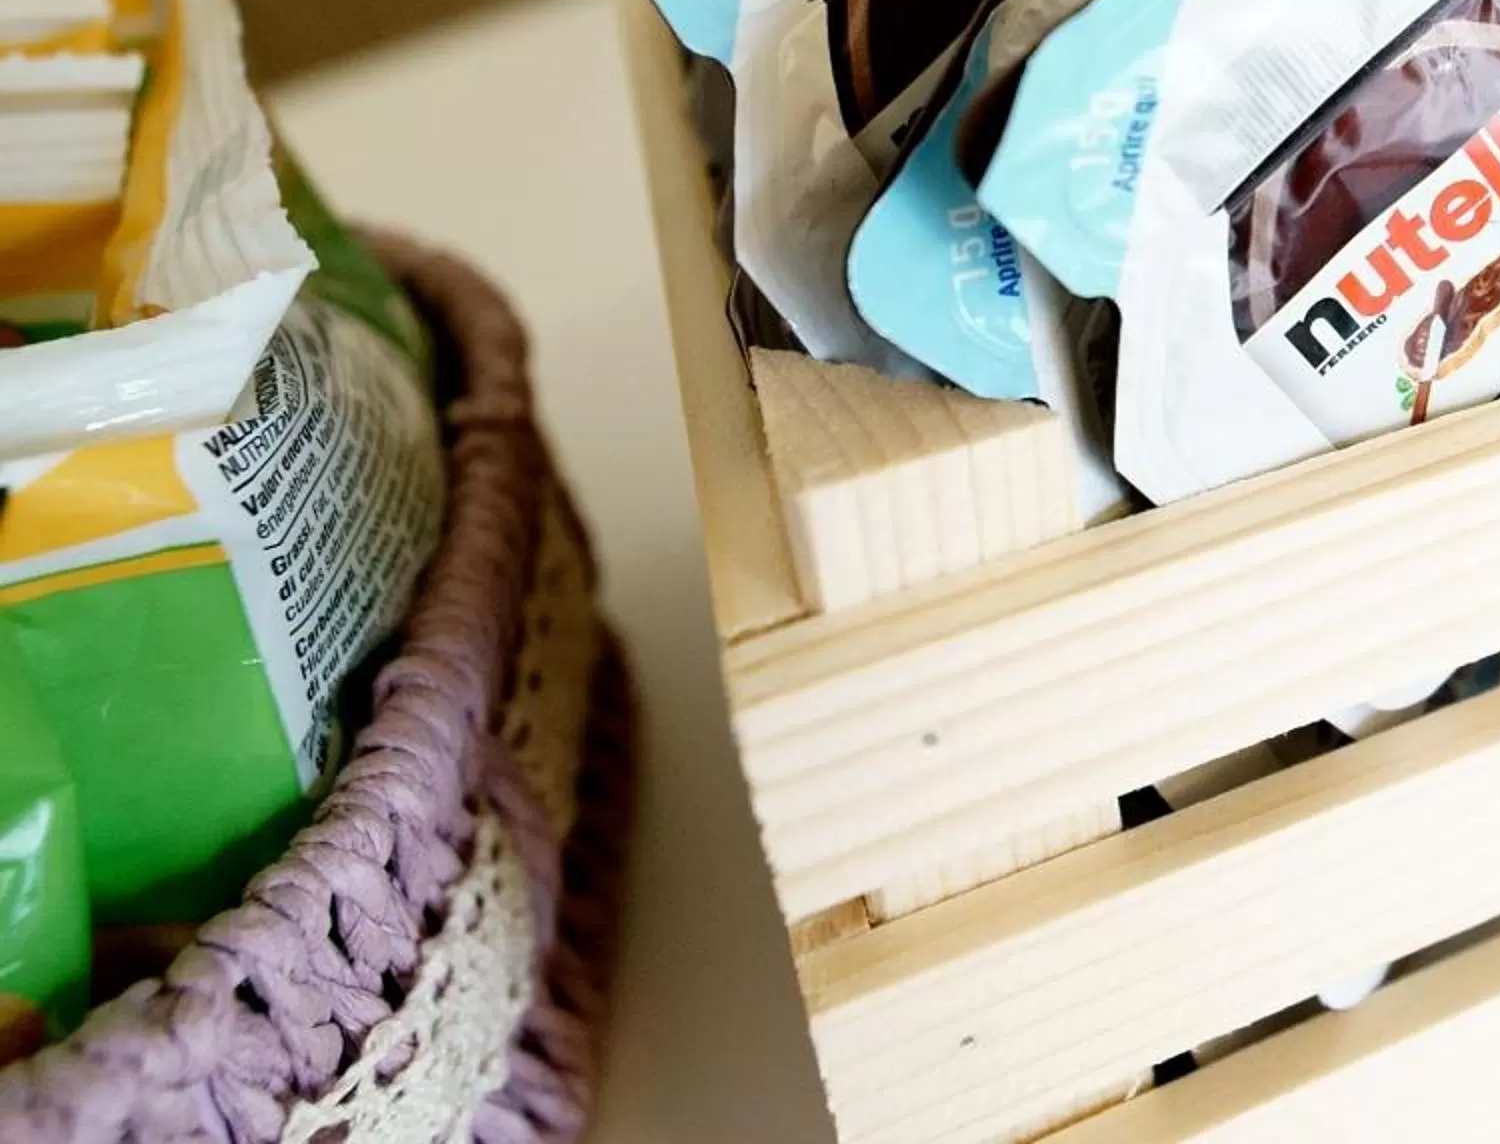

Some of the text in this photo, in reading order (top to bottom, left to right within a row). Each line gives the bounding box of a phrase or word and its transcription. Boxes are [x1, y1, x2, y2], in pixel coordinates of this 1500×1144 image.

[1111, 76, 1158, 193] Aprire qui
[1318, 313, 1387, 377] FERRERO
